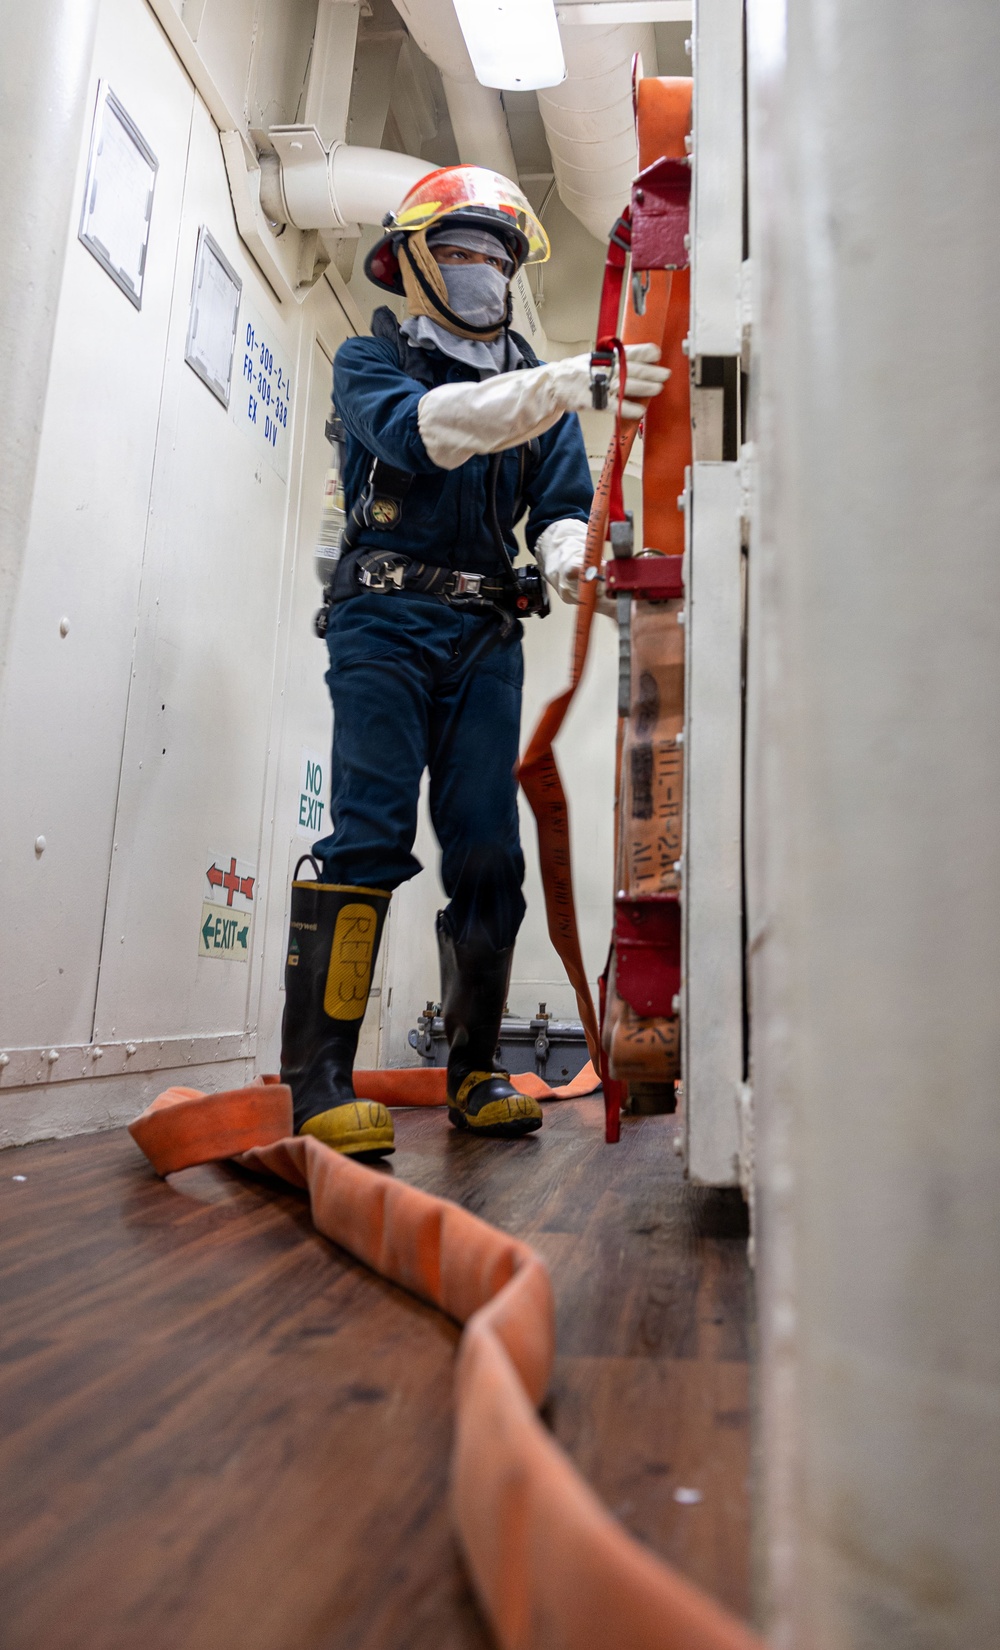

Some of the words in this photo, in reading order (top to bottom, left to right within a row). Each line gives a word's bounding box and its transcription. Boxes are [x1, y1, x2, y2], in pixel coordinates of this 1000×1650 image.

[246, 323, 290, 401] 01-309-2-L
[243, 354, 287, 428] FR-309-338
[248, 394, 257, 424] EX
[264, 415, 278, 447] DIV
[305, 760, 322, 796] NO
[298, 793, 324, 832] EXIT
[213, 917, 238, 949] EXIT
[290, 921, 317, 931] neywell
